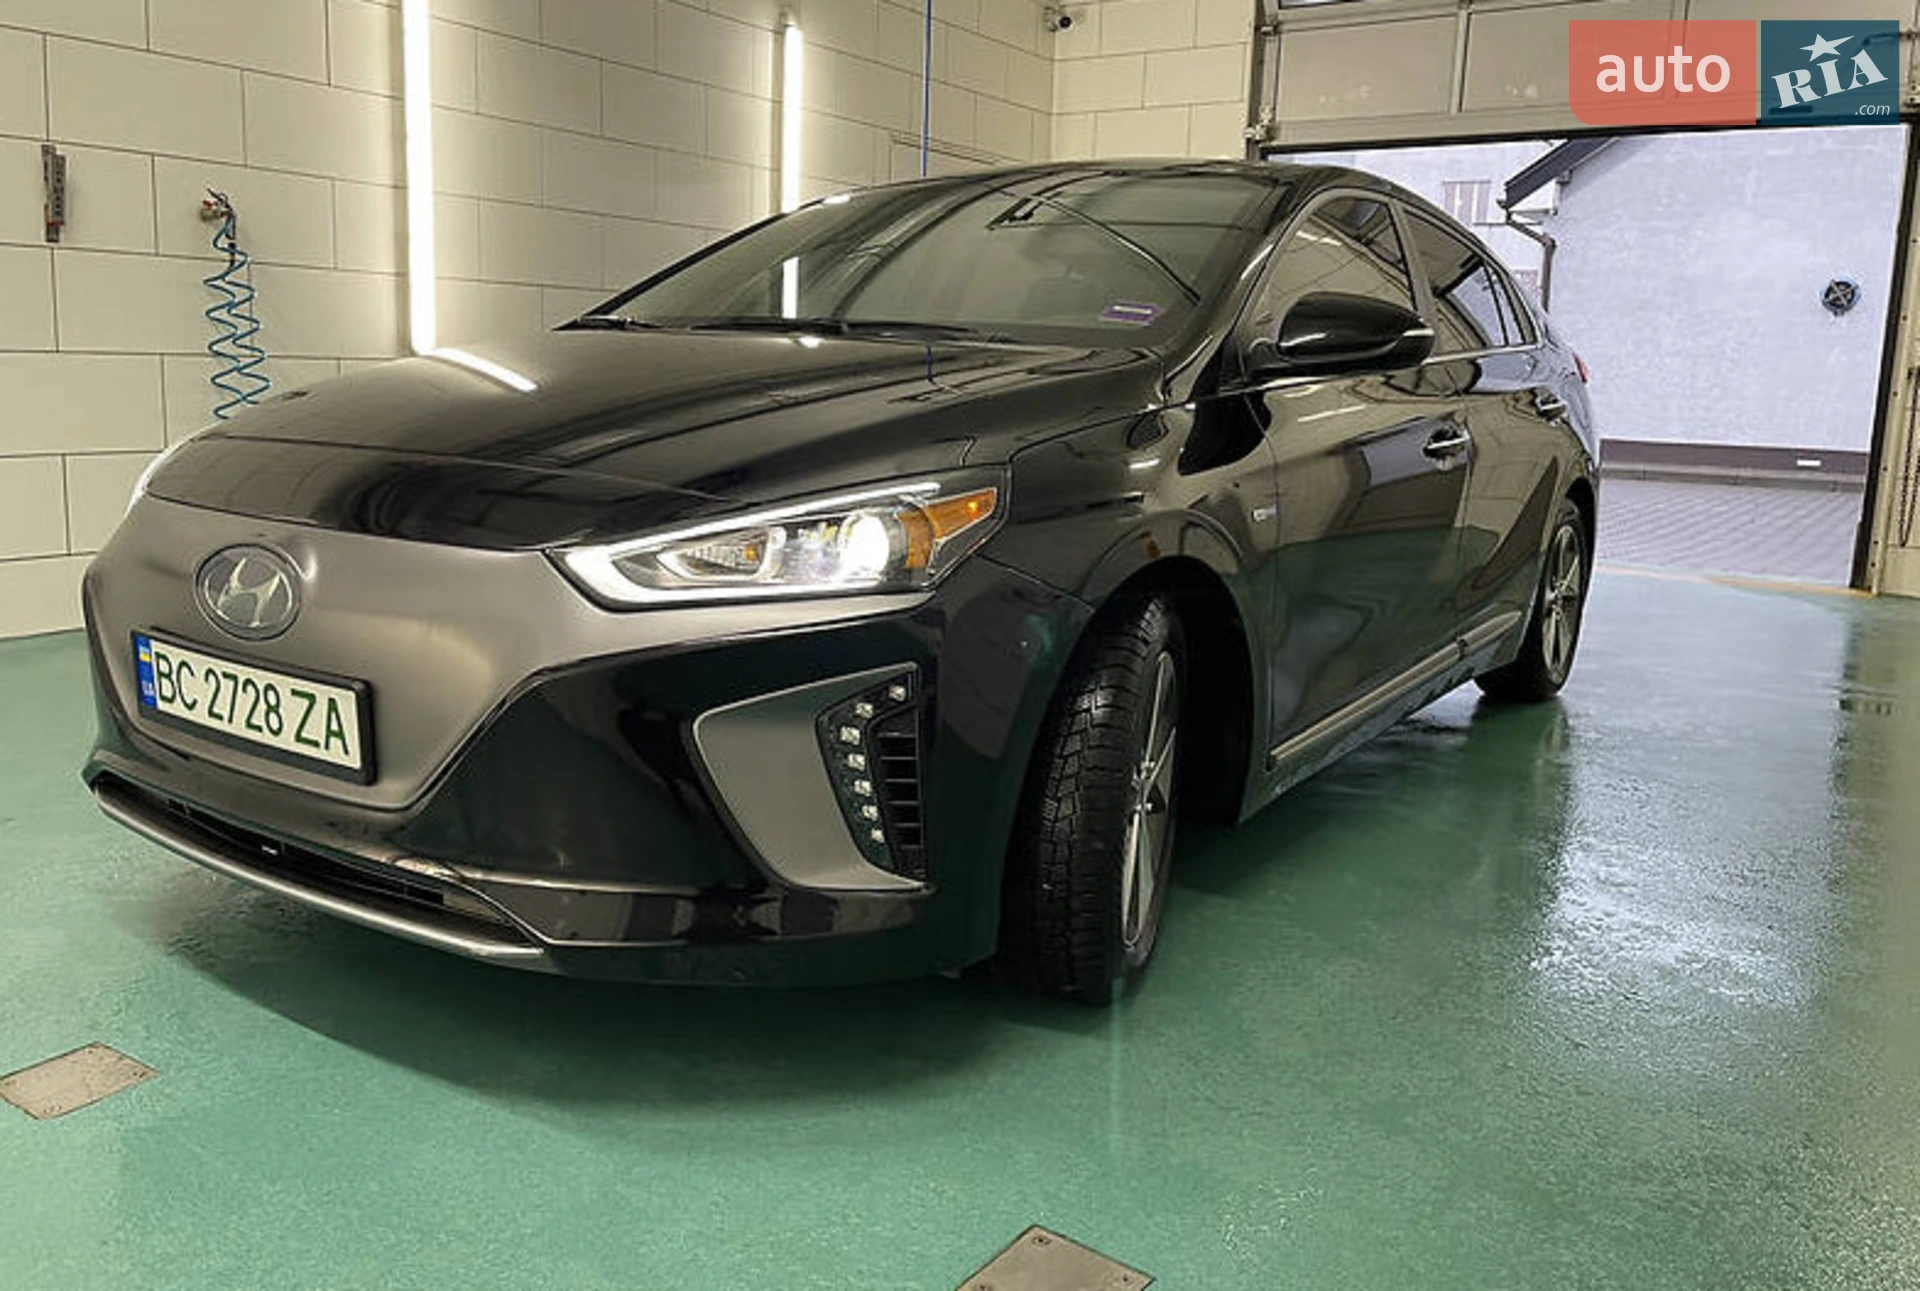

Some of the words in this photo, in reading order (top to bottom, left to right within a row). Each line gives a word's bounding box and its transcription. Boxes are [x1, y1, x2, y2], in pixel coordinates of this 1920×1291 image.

[154, 651, 198, 711] BC
[204, 668, 283, 737] 2728
[291, 688, 349, 756] ZA
